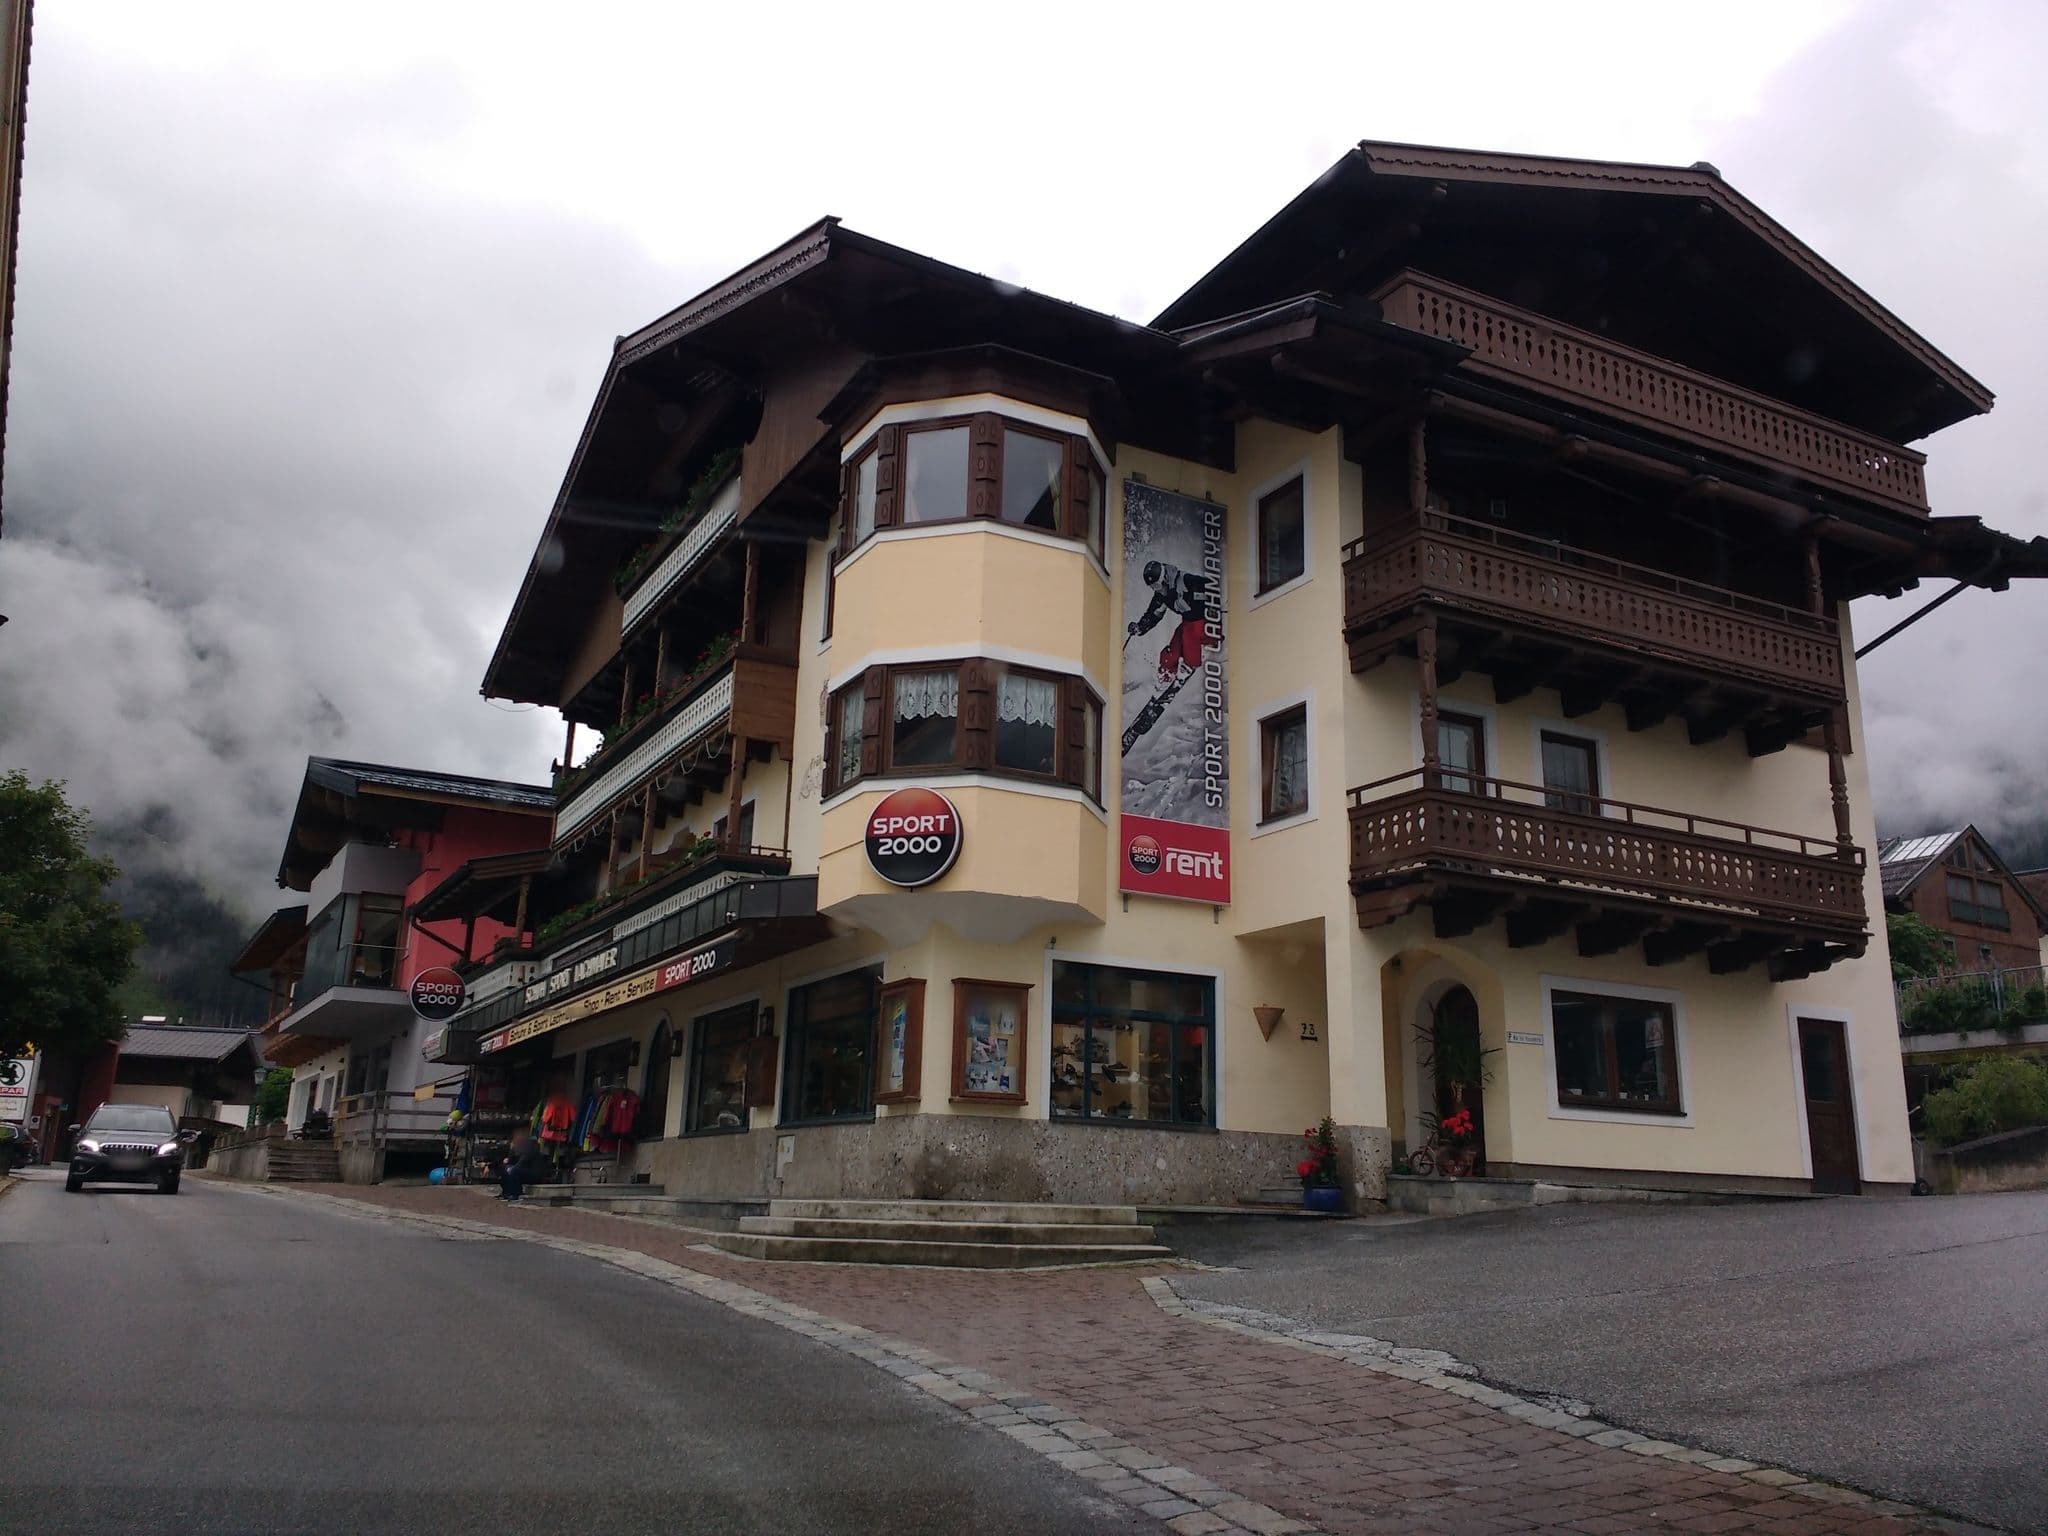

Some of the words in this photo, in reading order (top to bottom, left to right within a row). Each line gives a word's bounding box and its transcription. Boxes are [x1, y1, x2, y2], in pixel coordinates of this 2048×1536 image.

[1203, 510, 1222, 653] LACHMAYER
[1204, 661, 1223, 724] 2000
[1204, 728, 1223, 808] SPORT
[872, 815, 950, 835] SPORT
[878, 835, 942, 856] 2000
[1131, 846, 1159, 856] SPORT
[1134, 854, 1157, 864] 2000
[1165, 850, 1224, 880] rent
[665, 959, 691, 985] SPORT
[692, 950, 716, 975] 2000
[416, 982, 462, 994] SPORT
[418, 993, 457, 1005] 2000
[604, 989, 621, 1007] Rent
[627, 976, 655, 999] Service
